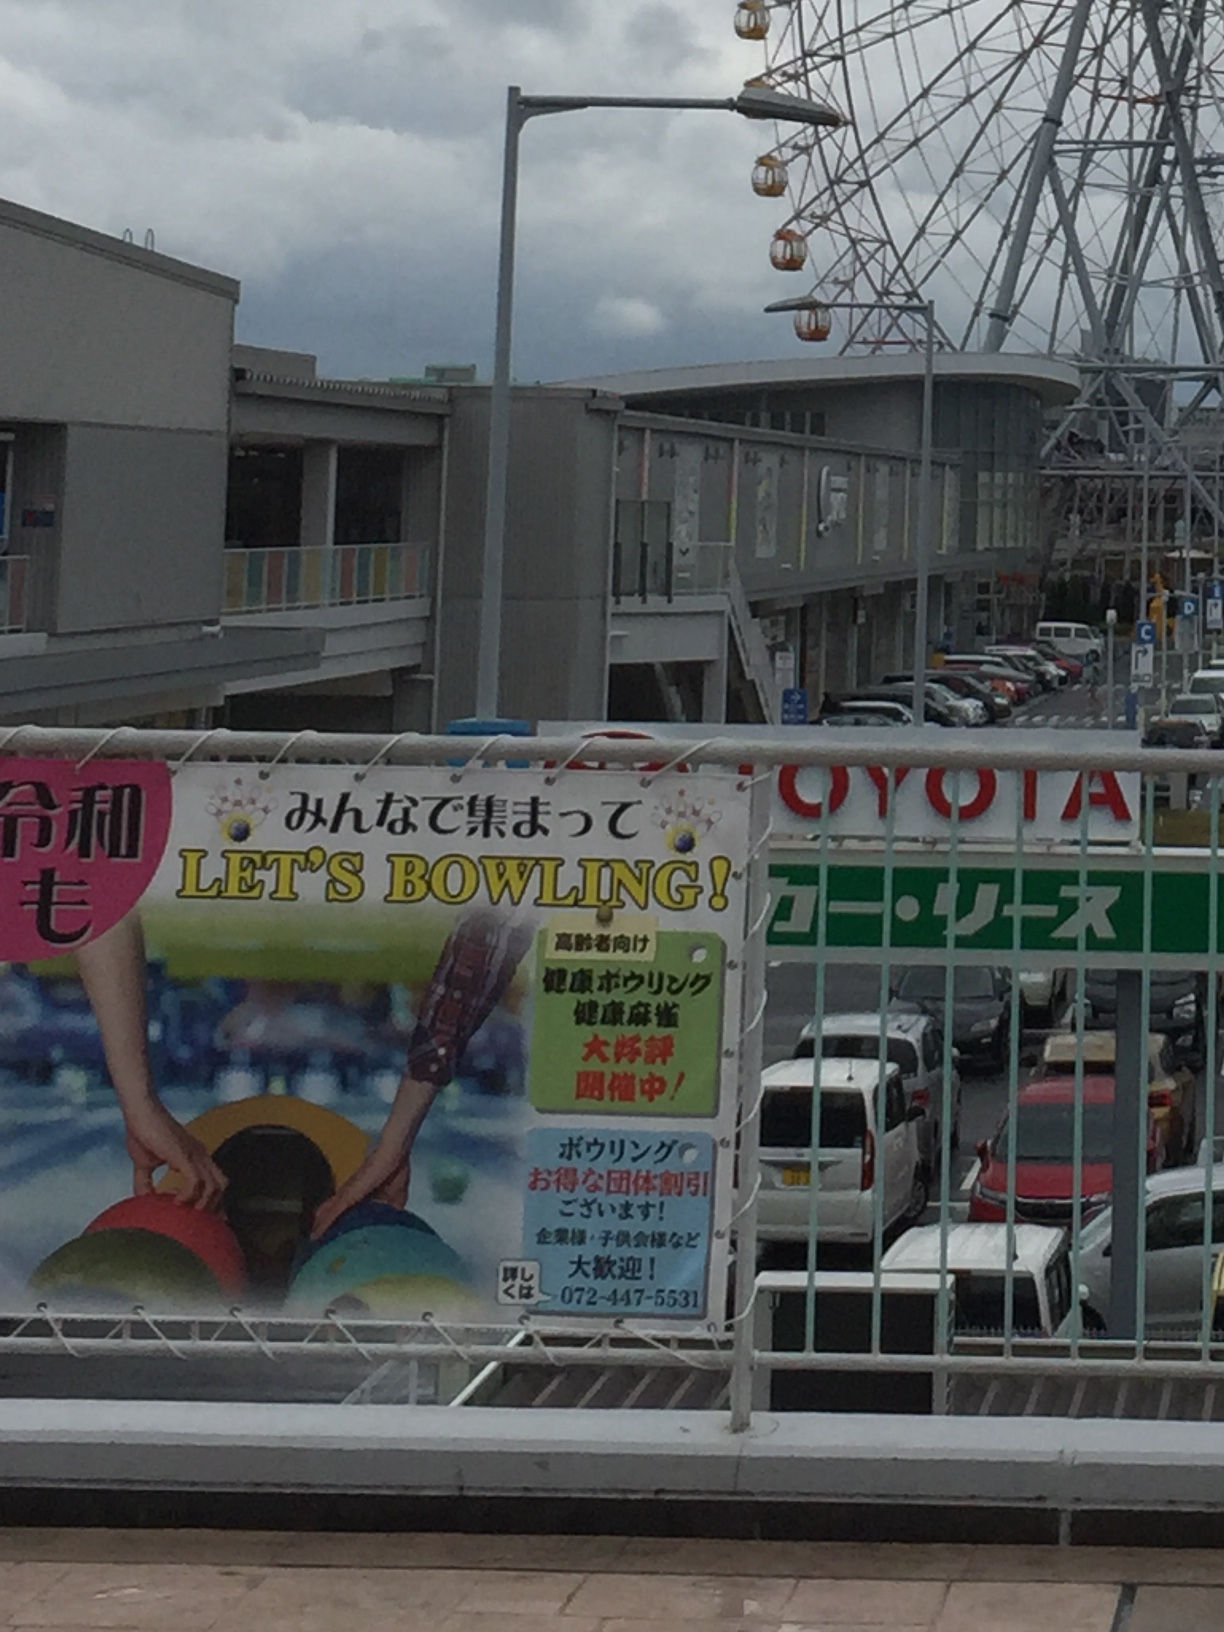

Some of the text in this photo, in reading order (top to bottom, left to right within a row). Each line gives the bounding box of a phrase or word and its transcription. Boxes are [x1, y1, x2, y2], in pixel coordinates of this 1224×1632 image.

[1140, 624, 1152, 640] C
[737, 764, 1133, 822] OYOTA
[0, 779, 145, 862] 令和
[284, 791, 643, 840] みんなで集まって
[176, 846, 732, 911] LET'S BOWLING!
[20, 868, 92, 945] も
[554, 932, 650, 954] 高齢者向け
[543, 967, 714, 997] 健康ボウリング
[574, 999, 681, 1029] 健康麻雀
[582, 1033, 675, 1066] 大好評
[575, 1070, 686, 1103] 開催中!
[558, 1135, 679, 1164] ボウリング
[527, 1167, 709, 1198] お得な団体割引
[558, 1197, 665, 1222] ございます!
[567, 1254, 656, 1282] 大歓迎!
[502, 1284, 535, 1300] くは
[560, 1285, 700, 1309] 072-447-5531
